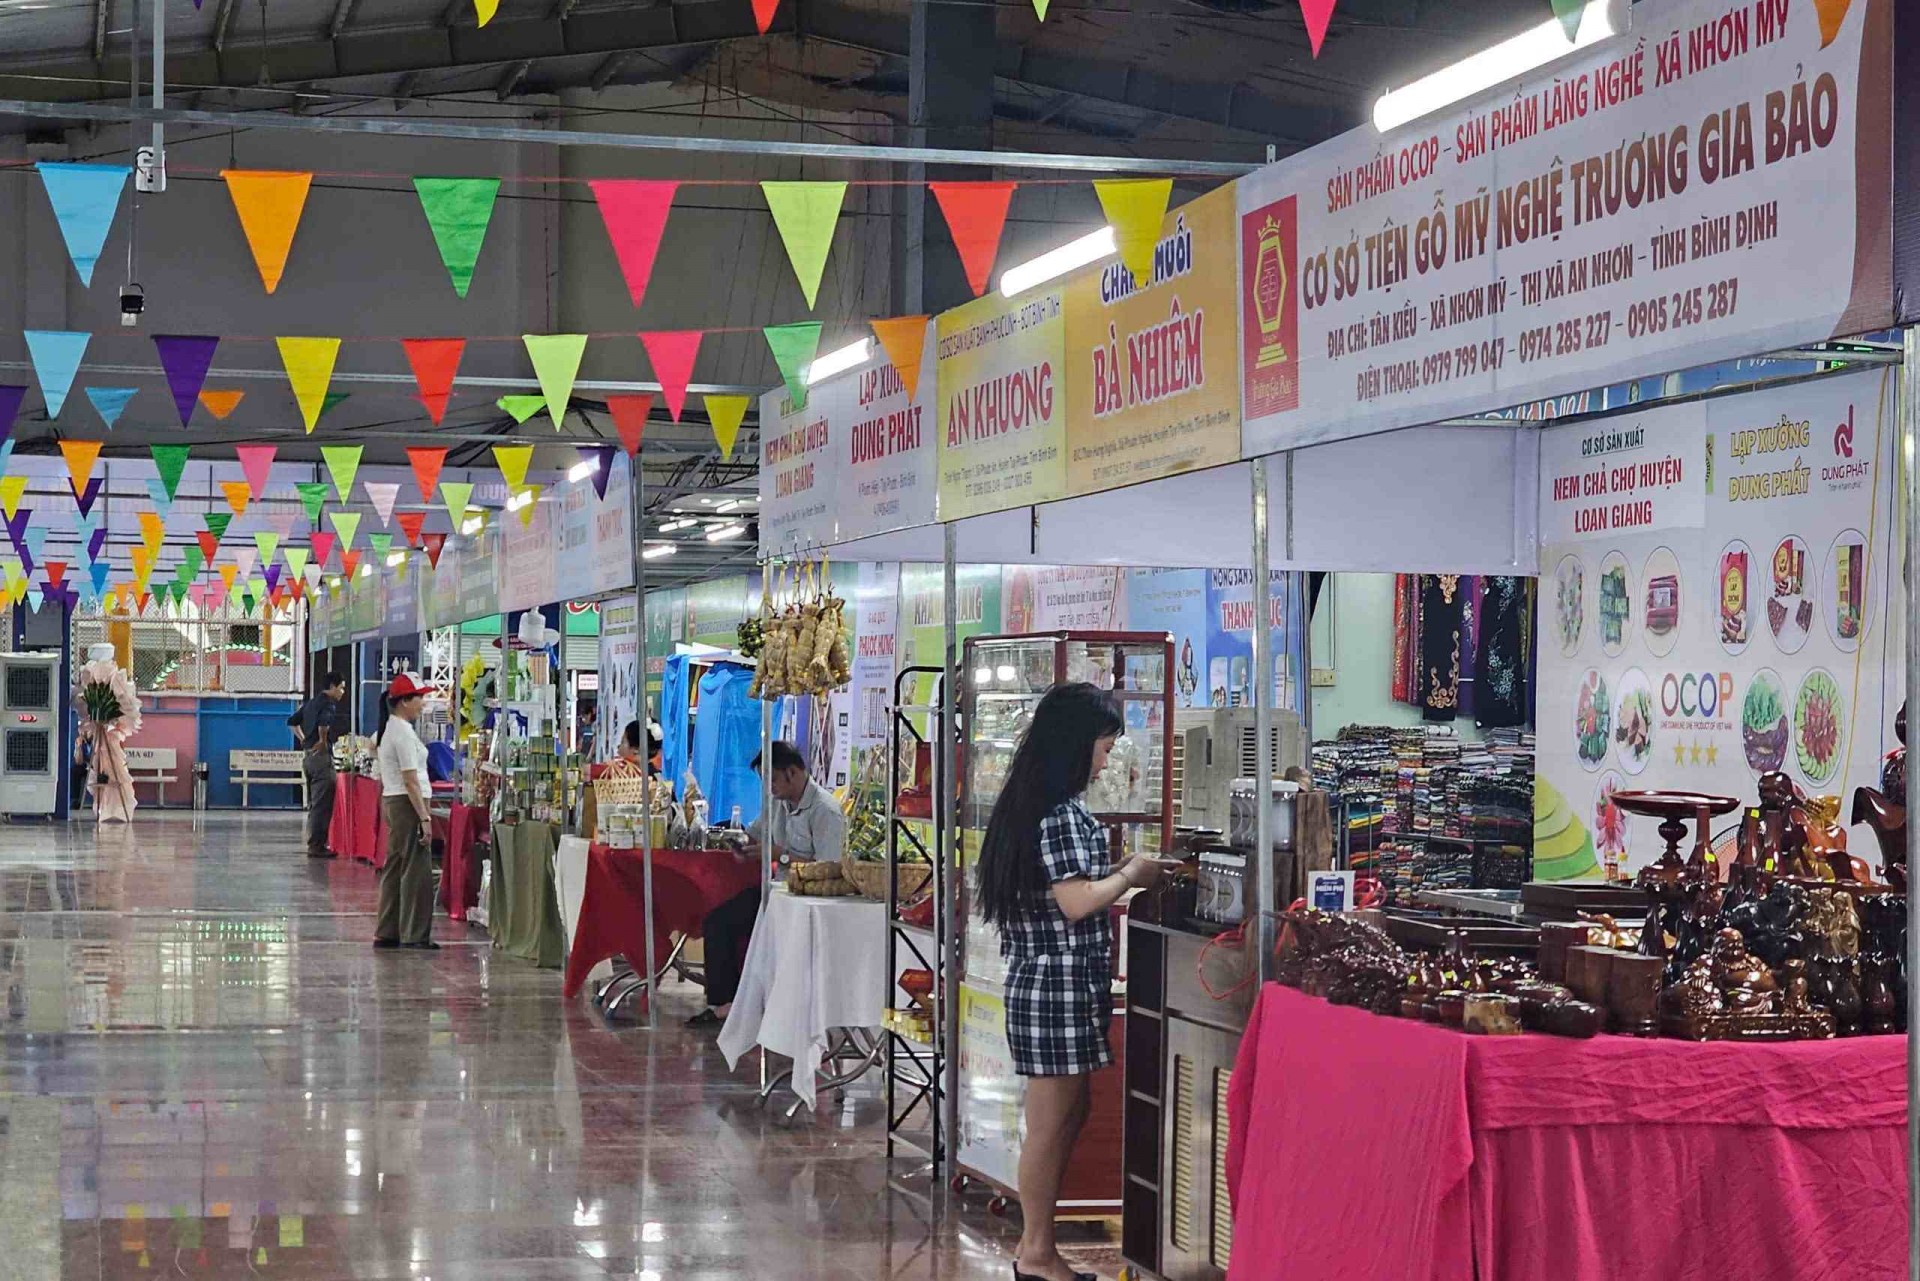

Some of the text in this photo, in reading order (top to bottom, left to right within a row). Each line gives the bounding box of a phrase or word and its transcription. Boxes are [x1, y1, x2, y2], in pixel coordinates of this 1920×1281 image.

[1327, 166, 1352, 214] SẢN
[1356, 143, 1395, 202] PHẨM
[1399, 135, 1439, 186] OCOP
[1456, 110, 1486, 164] SẢN
[1491, 83, 1538, 151] PHẨM
[1544, 77, 1589, 131] LÀNG
[1594, 37, 1646, 111] NGHỀ
[1655, 30, 1682, 88] XÃ
[1688, 7, 1748, 75] NHƠN
[1302, 62, 1838, 310] CƠ SỞ TIỆN GỖ MỸ NGHỆ TRƯƠNG GIA BẢO
[1155, 216, 1191, 282] MUỐI
[1327, 329, 1345, 361] ĐỊA
[1369, 310, 1390, 348] TÂN
[1393, 299, 1417, 342] KIỀU
[1430, 294, 1446, 331] XÃ
[1450, 284, 1484, 326] NHƠN
[1487, 276, 1507, 317] MỸ
[1521, 269, 1542, 307] THỊ
[1545, 259, 1564, 301] XÃ
[1568, 256, 1587, 294] AN
[1591, 242, 1634, 287] NHƠN
[1650, 225, 1686, 271] TỈNH
[1691, 215, 1730, 261] BÌNH
[1735, 200, 1778, 250] ĐỊNH
[1094, 299, 1203, 415] BÀ NHIÊM
[1357, 365, 1380, 402] ĐIỆN
[1383, 359, 1419, 394] THOẠI:
[1422, 351, 1451, 386] 0979
[1454, 344, 1477, 379] 799
[1481, 337, 1505, 373] 047
[1519, 325, 1551, 364] 0974
[1556, 317, 1582, 356] 285
[1585, 310, 1611, 349] 227
[1628, 295, 1667, 339] 0905
[1672, 287, 1702, 330] 245
[1707, 277, 1738, 320] 287
[859, 370, 877, 411] LẠP
[947, 362, 1053, 447] AN KHƯƠNG
[851, 403, 922, 465] DUNG PHÁT
[1582, 436, 1592, 455] CƠ
[1624, 422, 1644, 448] XUẤT
[1731, 430, 1756, 465] LẠP
[1554, 455, 1682, 501] NEM CHẢ CHỢ HUYỆN
[1729, 456, 1811, 501] DUNG PHÁT
[1822, 459, 1869, 480] DUNG PHÁT
[1575, 500, 1652, 533] LOAN GIANG
[1661, 672, 1733, 717] OCOP
